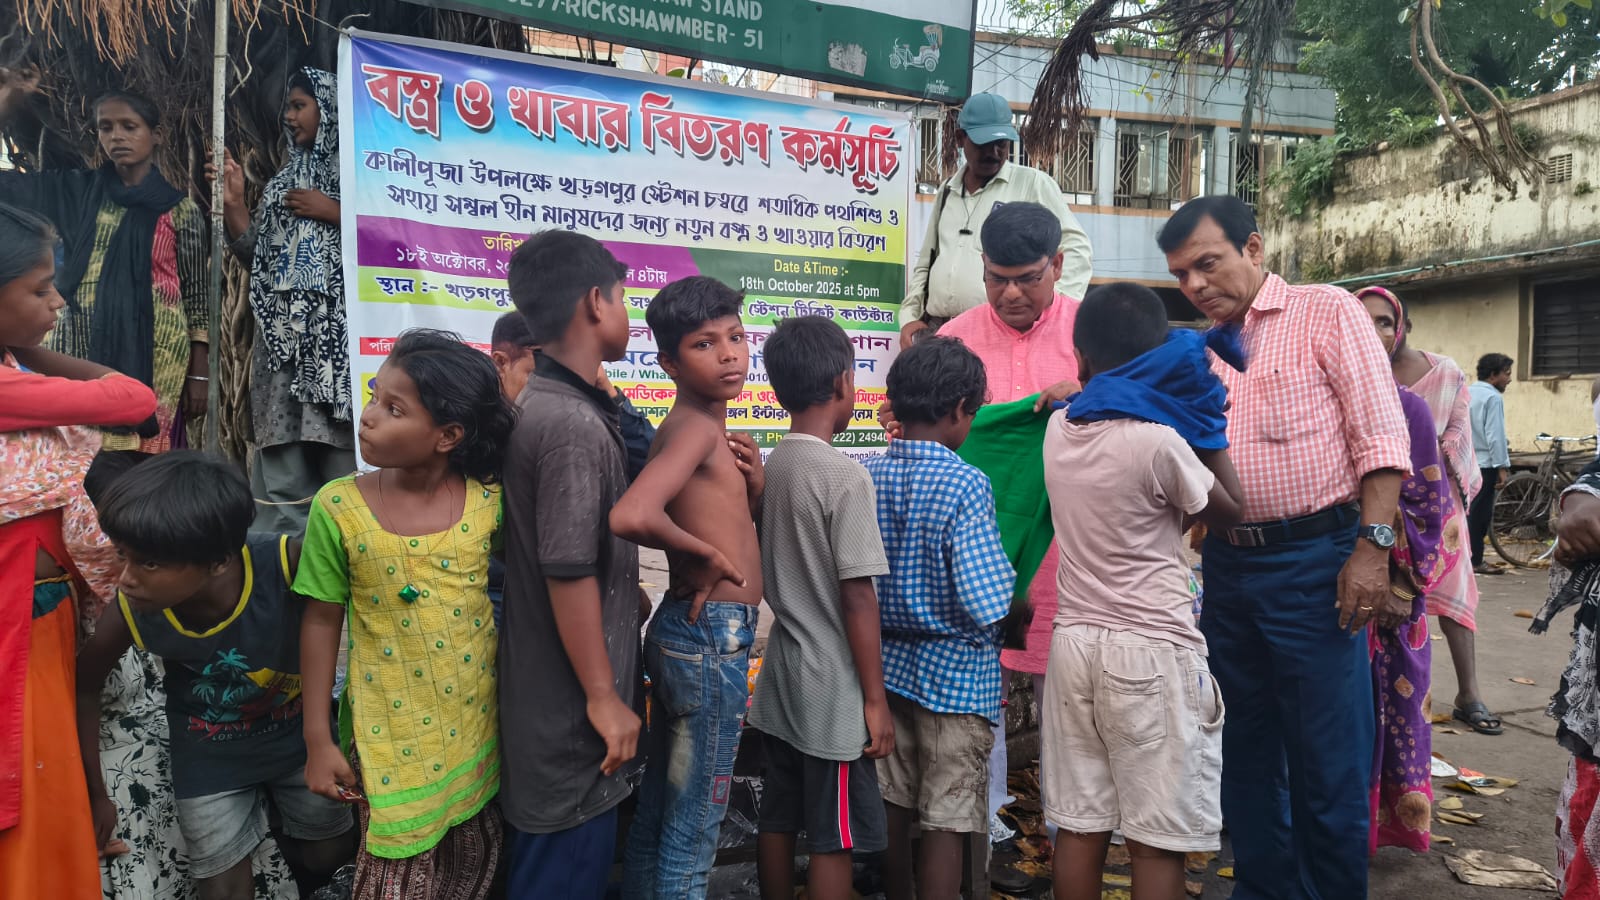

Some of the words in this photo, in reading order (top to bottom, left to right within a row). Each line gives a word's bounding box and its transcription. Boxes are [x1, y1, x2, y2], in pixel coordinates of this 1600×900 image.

[743, 28, 763, 50] 51
[362, 63, 442, 138] বস্ত্র
[454, 80, 494, 130] ও
[507, 86, 631, 150] খাবার
[640, 91, 770, 164] বিতরণ
[778, 116, 900, 192] কর্মসূচি
[364, 148, 464, 188] কালীপূজা
[468, 159, 553, 193] উপলক্ষে
[558, 176, 636, 205] খড়গপুর
[641, 180, 700, 208] স্টেশন
[704, 191, 749, 214] চত্বরে
[757, 193, 820, 219] শতাধিক
[888, 209, 900, 226] ও
[386, 184, 438, 214] সহায়
[444, 194, 498, 218] সম্বল
[500, 193, 537, 222] হীন
[541, 204, 625, 231] মানুষদের
[628, 213, 672, 238] জন্য
[674, 218, 714, 241] নতুন
[755, 224, 769, 242] ও
[773, 227, 835, 249] খাওয়ার
[838, 226, 887, 252] বিতরণ
[774, 259, 800, 273] Date
[376, 276, 415, 294] স্থান
[740, 276, 764, 290] 18th
[768, 278, 814, 293] October
[816, 281, 841, 295] 2025
[844, 284, 854, 296] at
[857, 284, 880, 299] 5pm
[749, 300, 789, 316] স্টেশন
[838, 305, 893, 322] কাউন্টার
